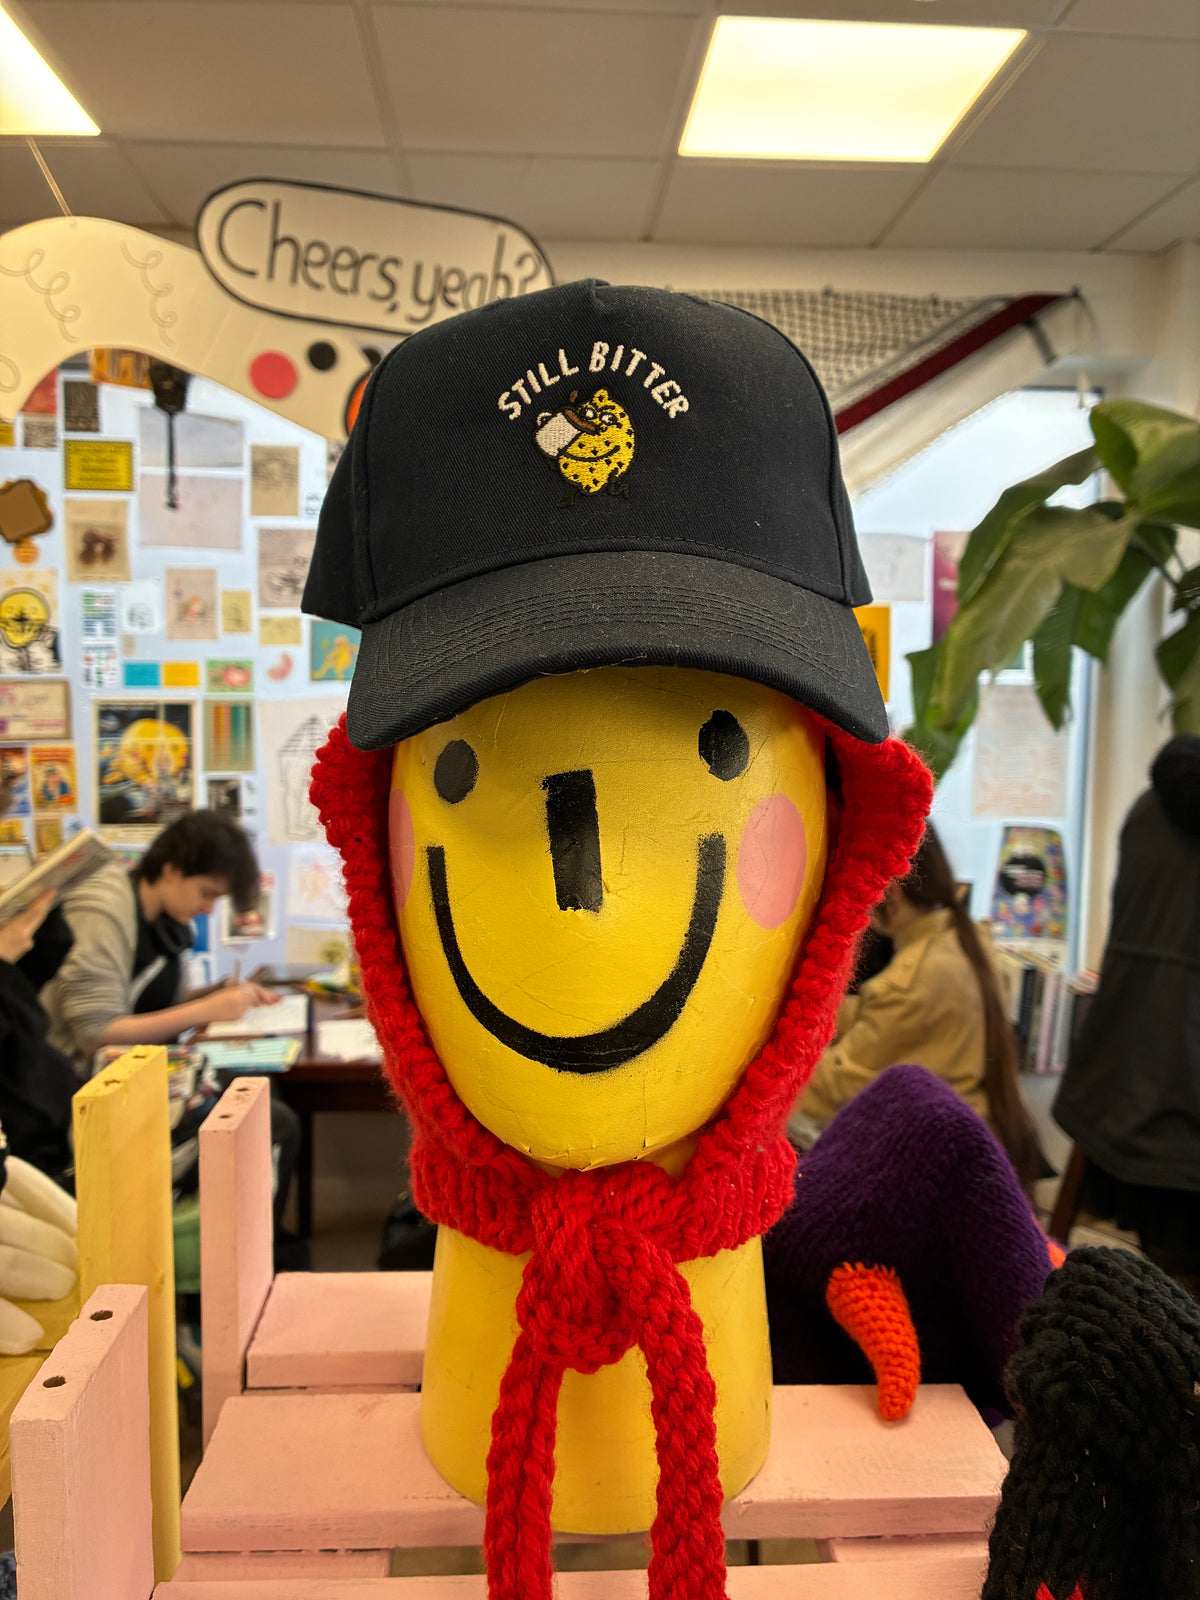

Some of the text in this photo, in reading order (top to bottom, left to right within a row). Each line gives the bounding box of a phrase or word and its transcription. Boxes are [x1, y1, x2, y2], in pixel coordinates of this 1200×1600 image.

[218, 199, 543, 325] Cheers, yeah?
[498, 341, 690, 420] STILL BITTER
